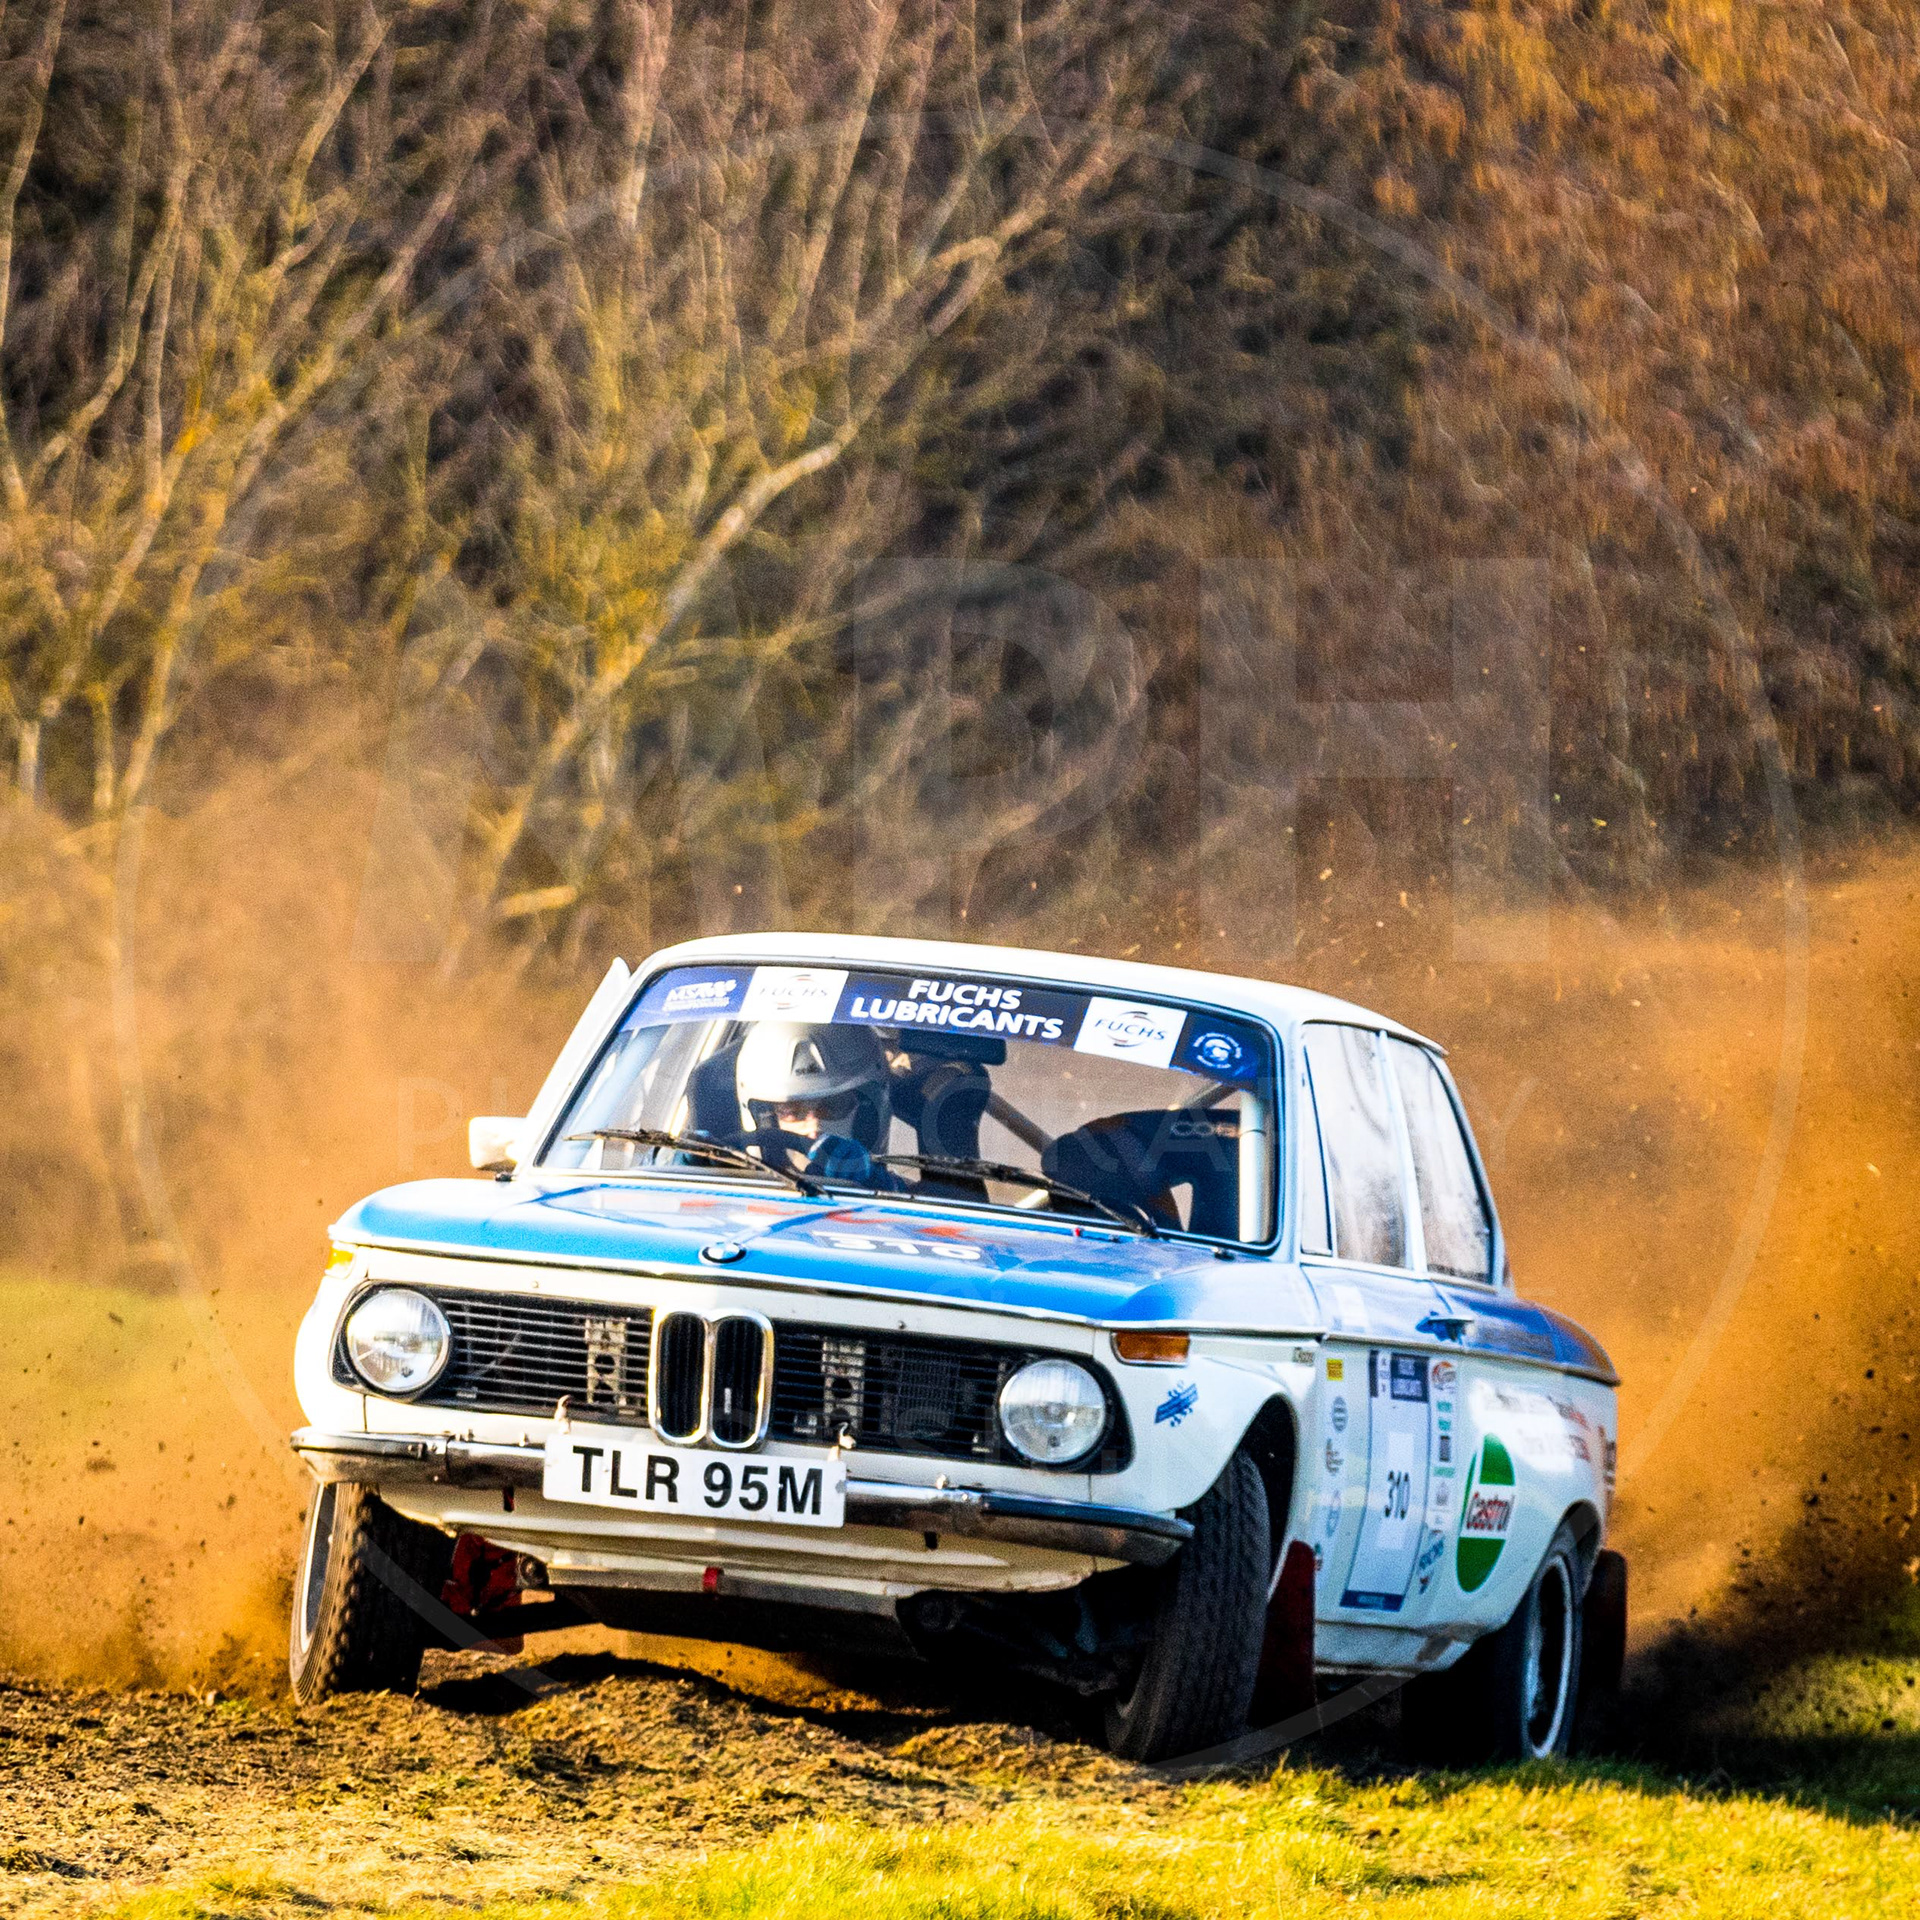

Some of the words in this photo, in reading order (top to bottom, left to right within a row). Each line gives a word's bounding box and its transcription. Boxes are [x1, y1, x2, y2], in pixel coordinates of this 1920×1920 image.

[759, 986, 828, 998] FUCHS
[908, 979, 1022, 1010] FUCHS
[850, 997, 1064, 1039] LUBRICANTS
[1094, 1018, 1168, 1041] FUCHS
[572, 1445, 680, 1503] TLR
[703, 1461, 823, 1516] 95M
[1384, 1470, 1411, 1520] 310
